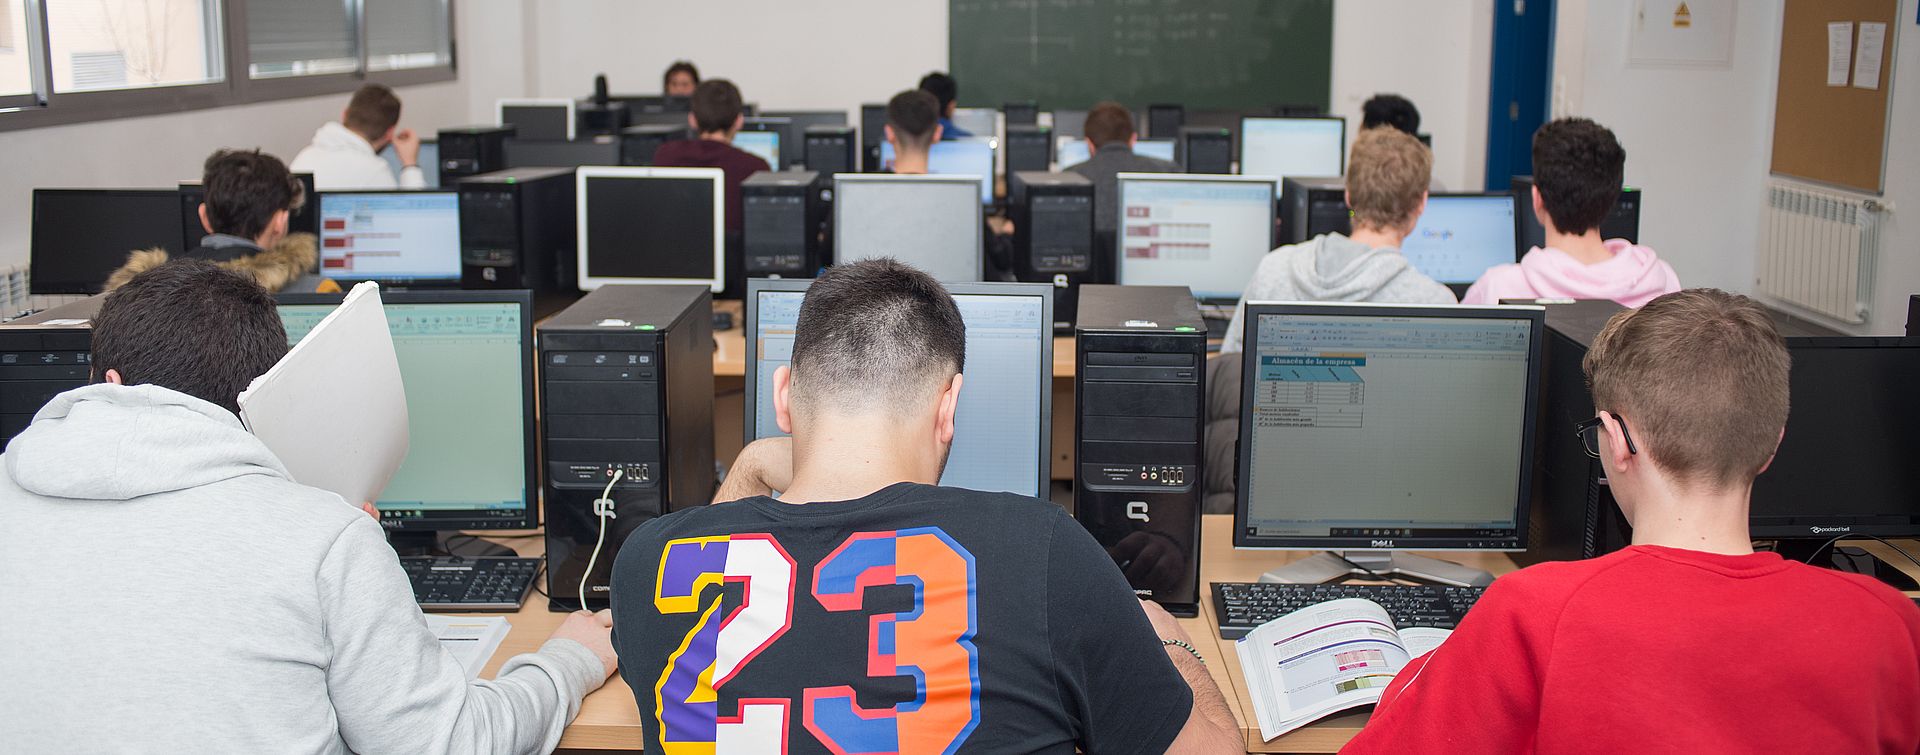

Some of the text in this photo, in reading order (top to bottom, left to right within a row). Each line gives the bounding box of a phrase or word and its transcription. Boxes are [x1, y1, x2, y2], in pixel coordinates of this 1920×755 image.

[1271, 356, 1356, 367] Almacén de la empresa
[1371, 540, 1395, 548] DELL
[654, 526, 981, 755] 23
